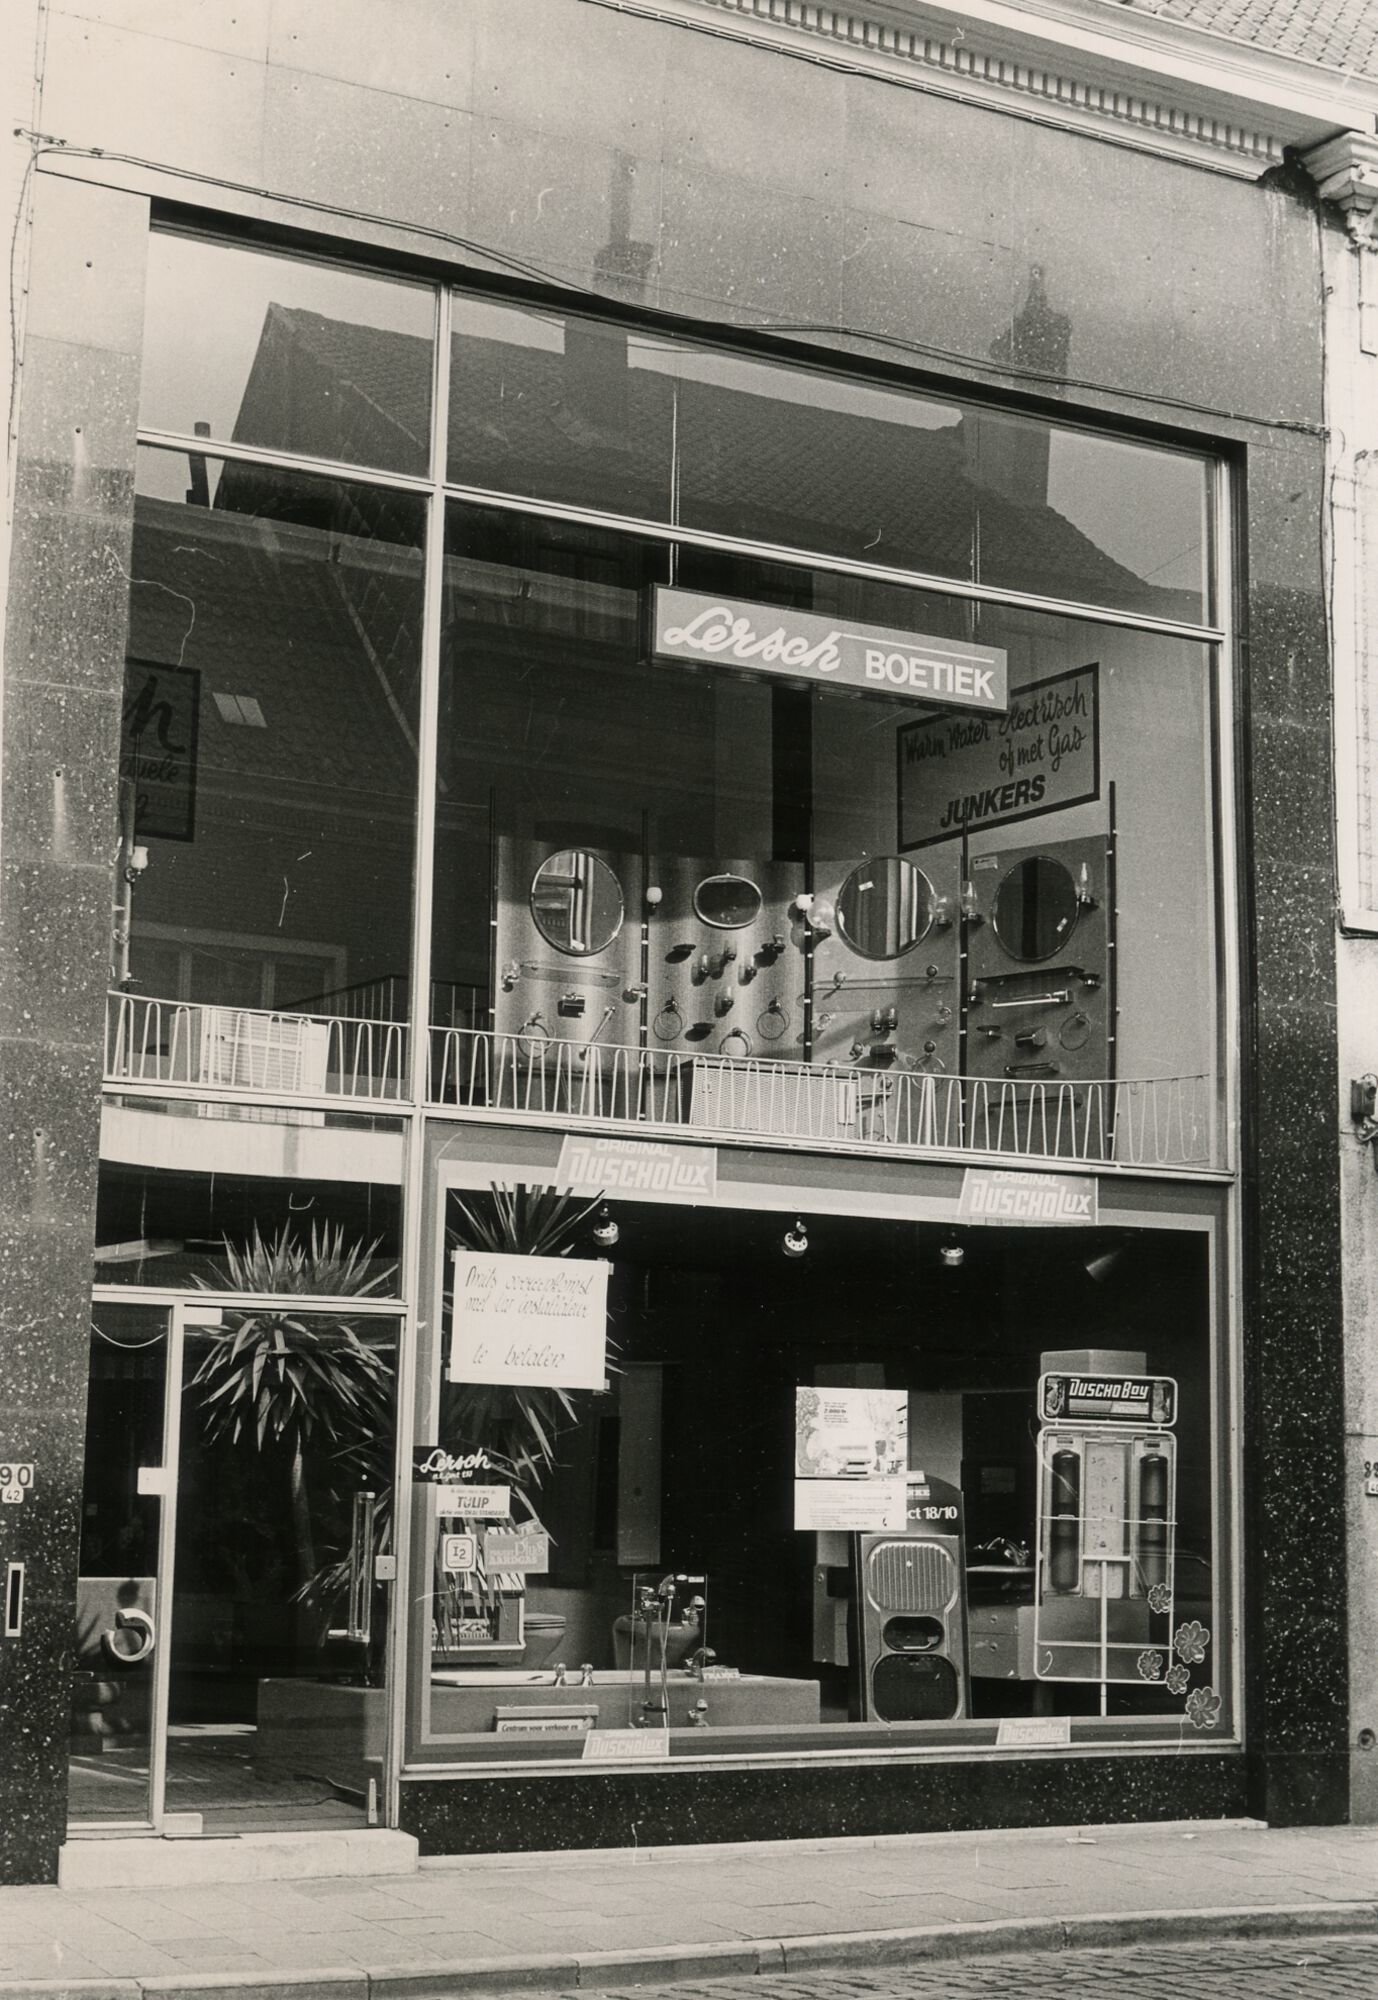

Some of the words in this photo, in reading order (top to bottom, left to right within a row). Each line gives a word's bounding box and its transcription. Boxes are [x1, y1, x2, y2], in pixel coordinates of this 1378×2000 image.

[663, 606, 842, 672] Lersch
[865, 649, 996, 699] BOETIEK
[1017, 735, 1044, 767] met
[1048, 724, 1086, 772] Gas
[940, 775, 1046, 828] JUNKERS
[596, 1139, 672, 1157] ORIGINAL
[992, 1171, 1059, 1187] ORIGINAL
[504, 1344, 566, 1369] betalen
[0, 1466, 31, 1486] 90
[6, 1490, 20, 1501] 42
[457, 1496, 490, 1509] TULIP
[924, 1505, 958, 1520] 18/10
